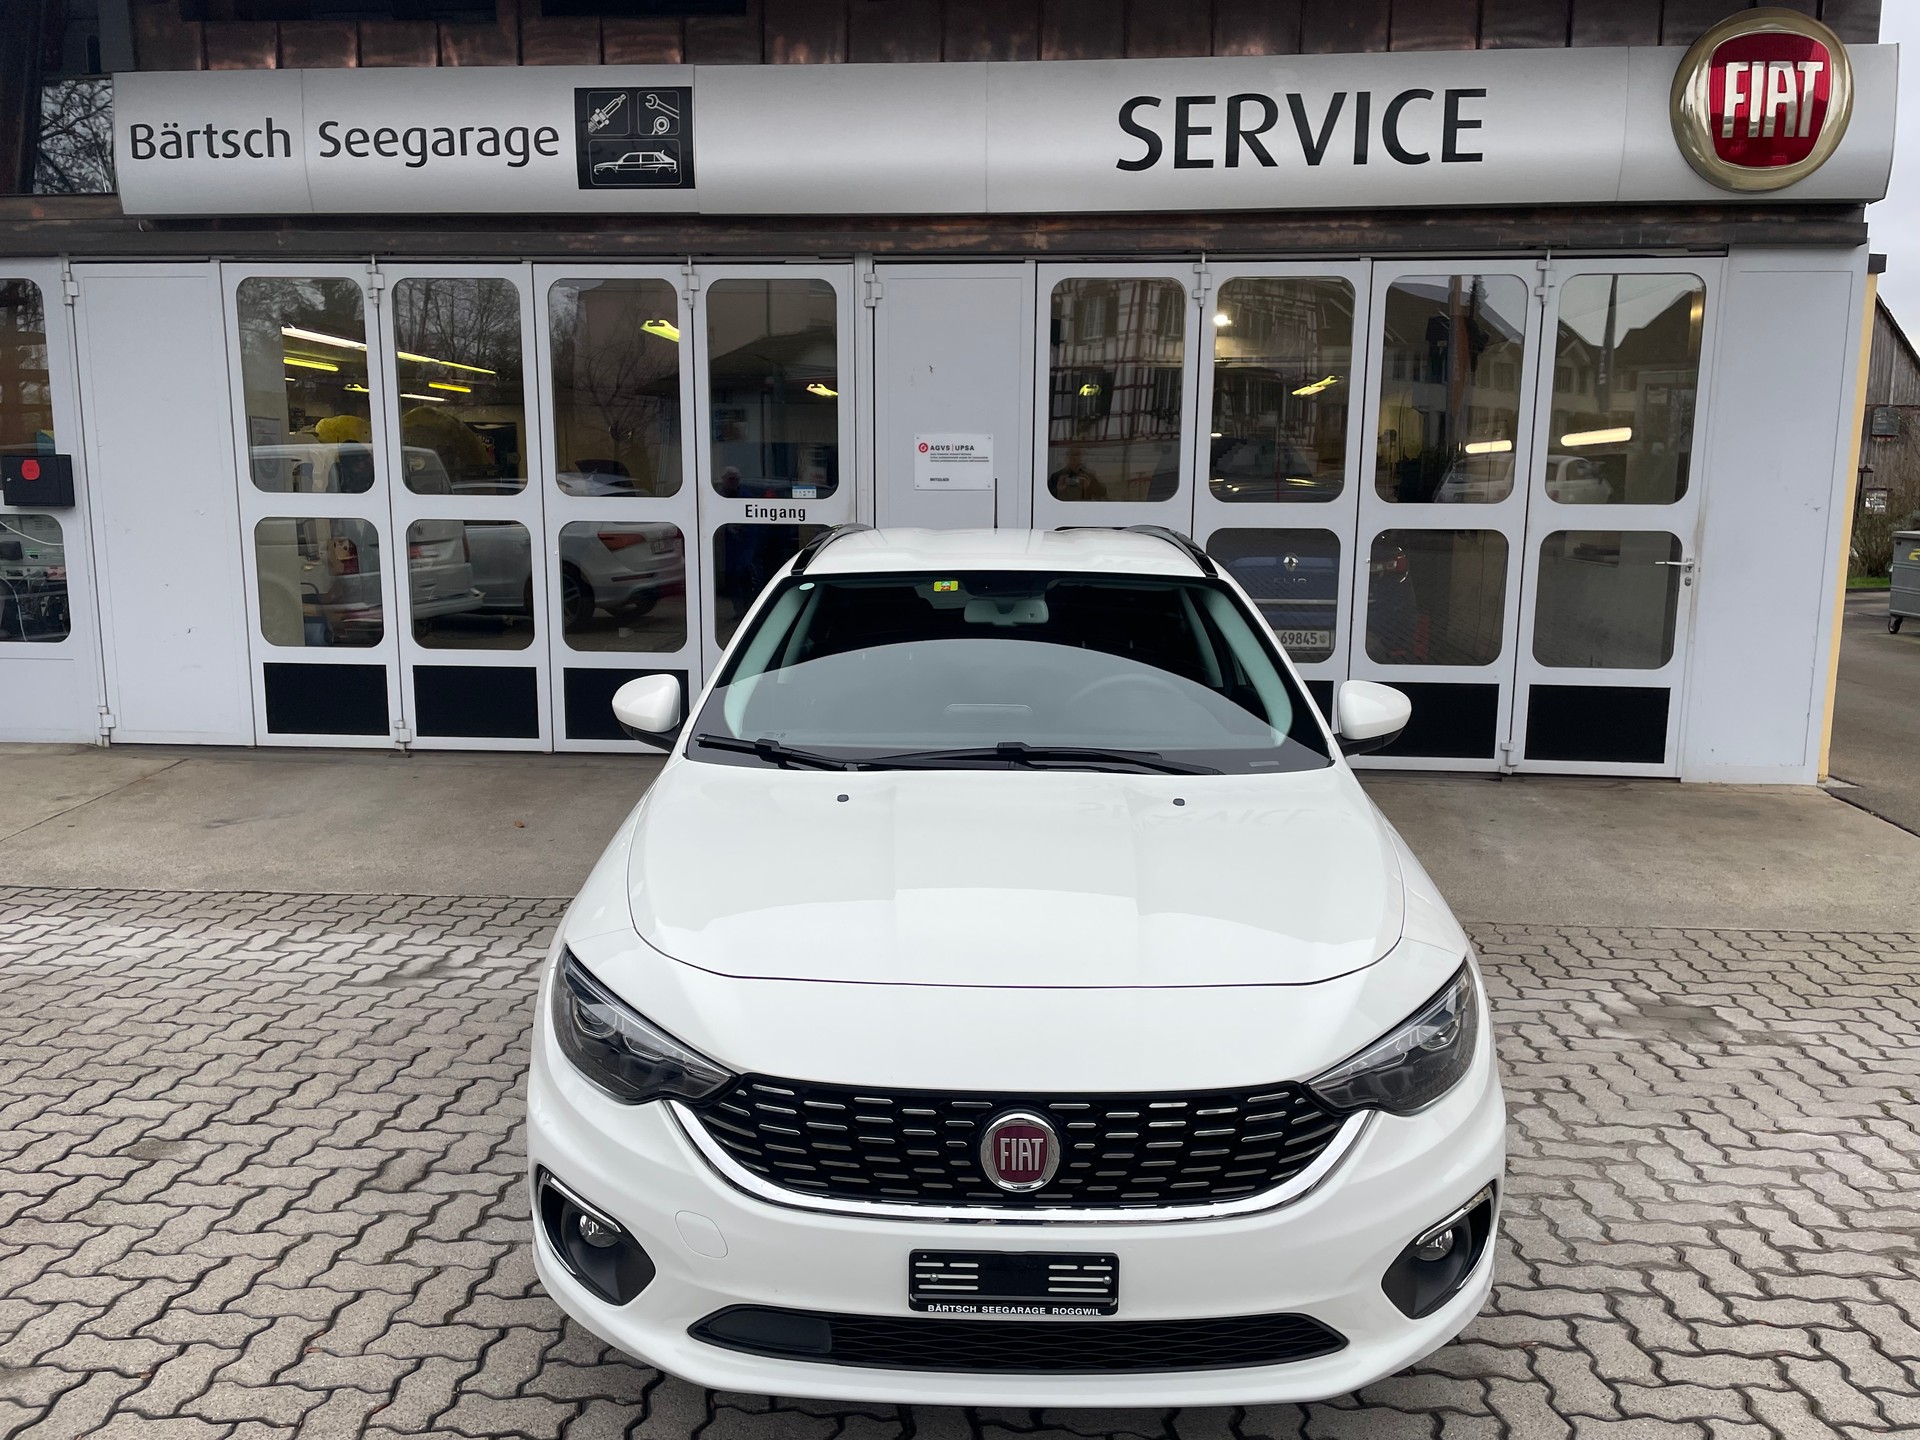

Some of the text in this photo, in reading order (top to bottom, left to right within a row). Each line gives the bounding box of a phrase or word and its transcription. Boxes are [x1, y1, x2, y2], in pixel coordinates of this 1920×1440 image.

[1722, 61, 1824, 138] FIAT
[130, 118, 559, 167] Bärtsch Seegarage
[1116, 87, 1487, 171] SERVICE
[745, 504, 806, 522] Eingang
[1280, 631, 1318, 645] 69845
[1000, 1138, 1044, 1171] FIAT
[927, 1304, 1102, 1316] BÄRTSCH SEEGARAGE ROGGWIL
